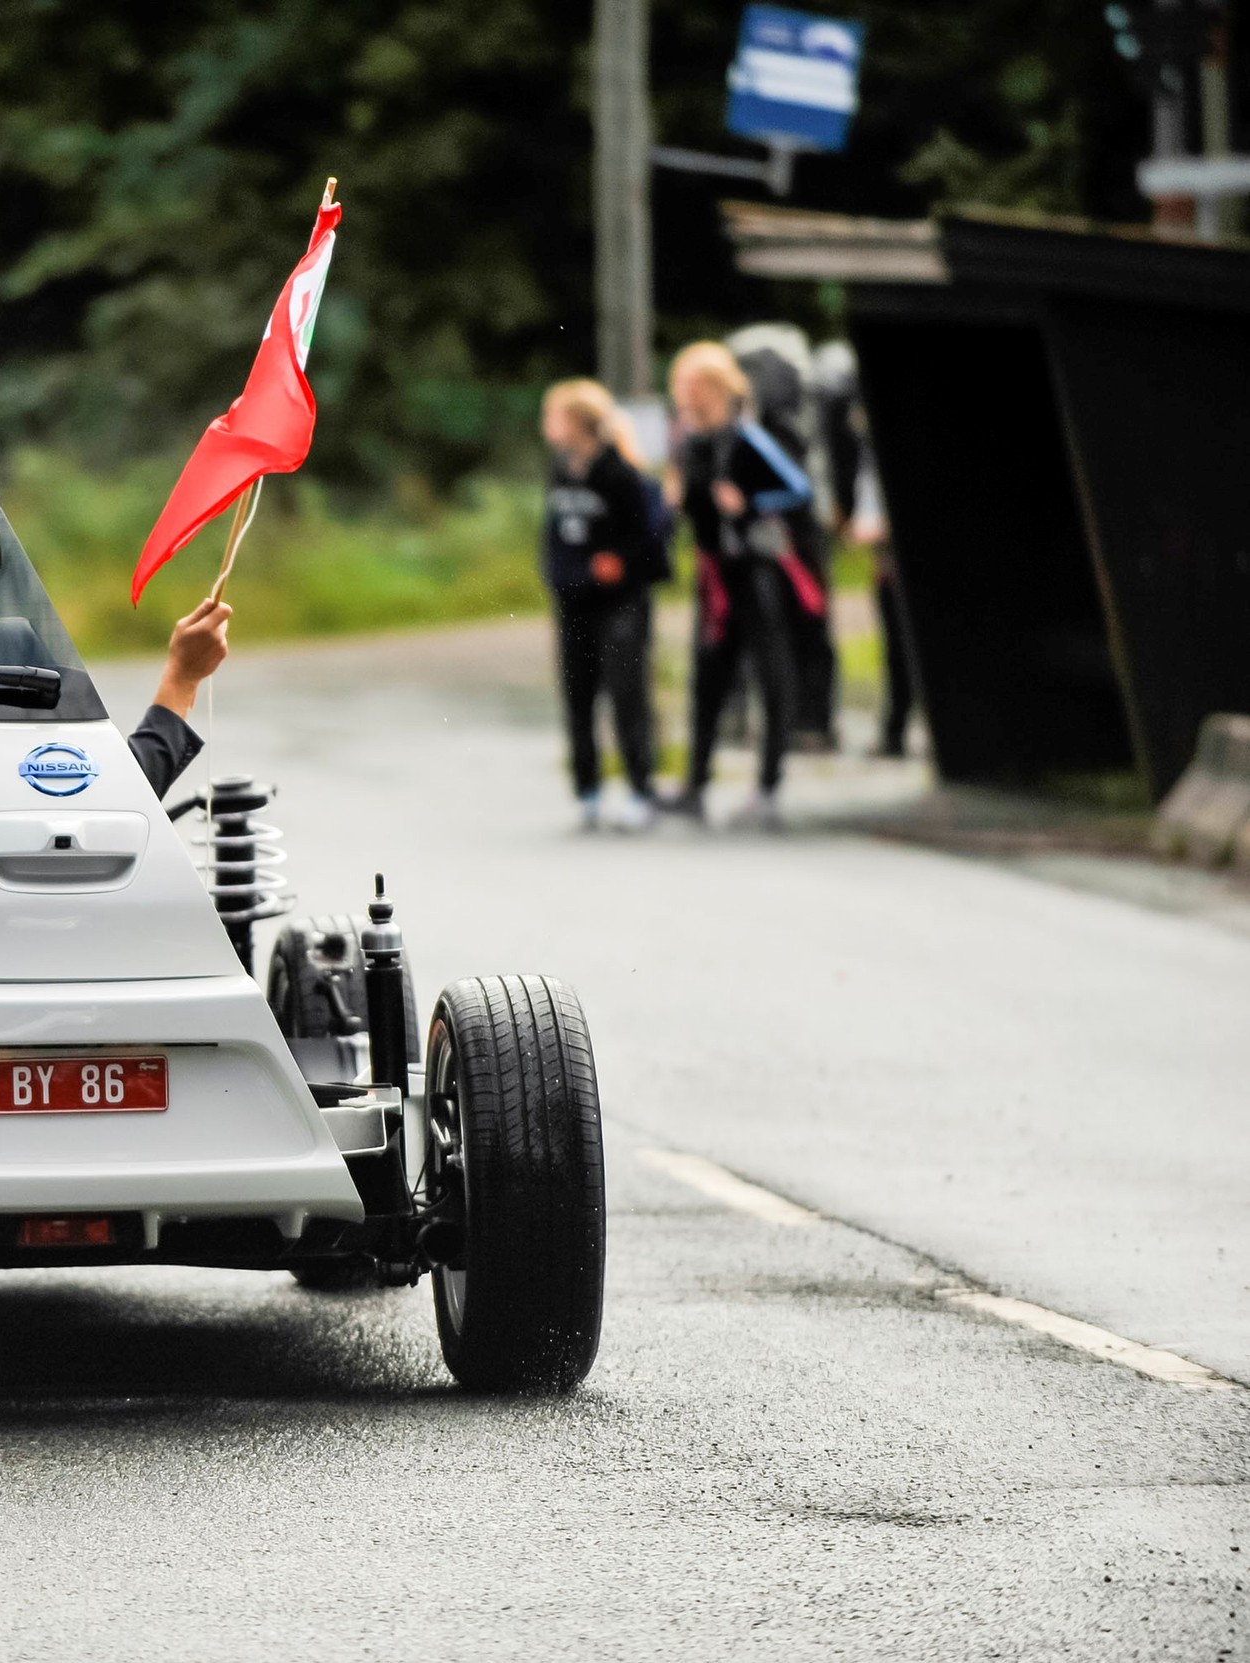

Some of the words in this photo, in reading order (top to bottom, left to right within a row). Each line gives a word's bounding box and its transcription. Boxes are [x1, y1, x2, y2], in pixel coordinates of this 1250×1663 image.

[27, 762, 92, 772] NISSAN
[12, 1065, 54, 1106] BY
[80, 1063, 125, 1104] 86
